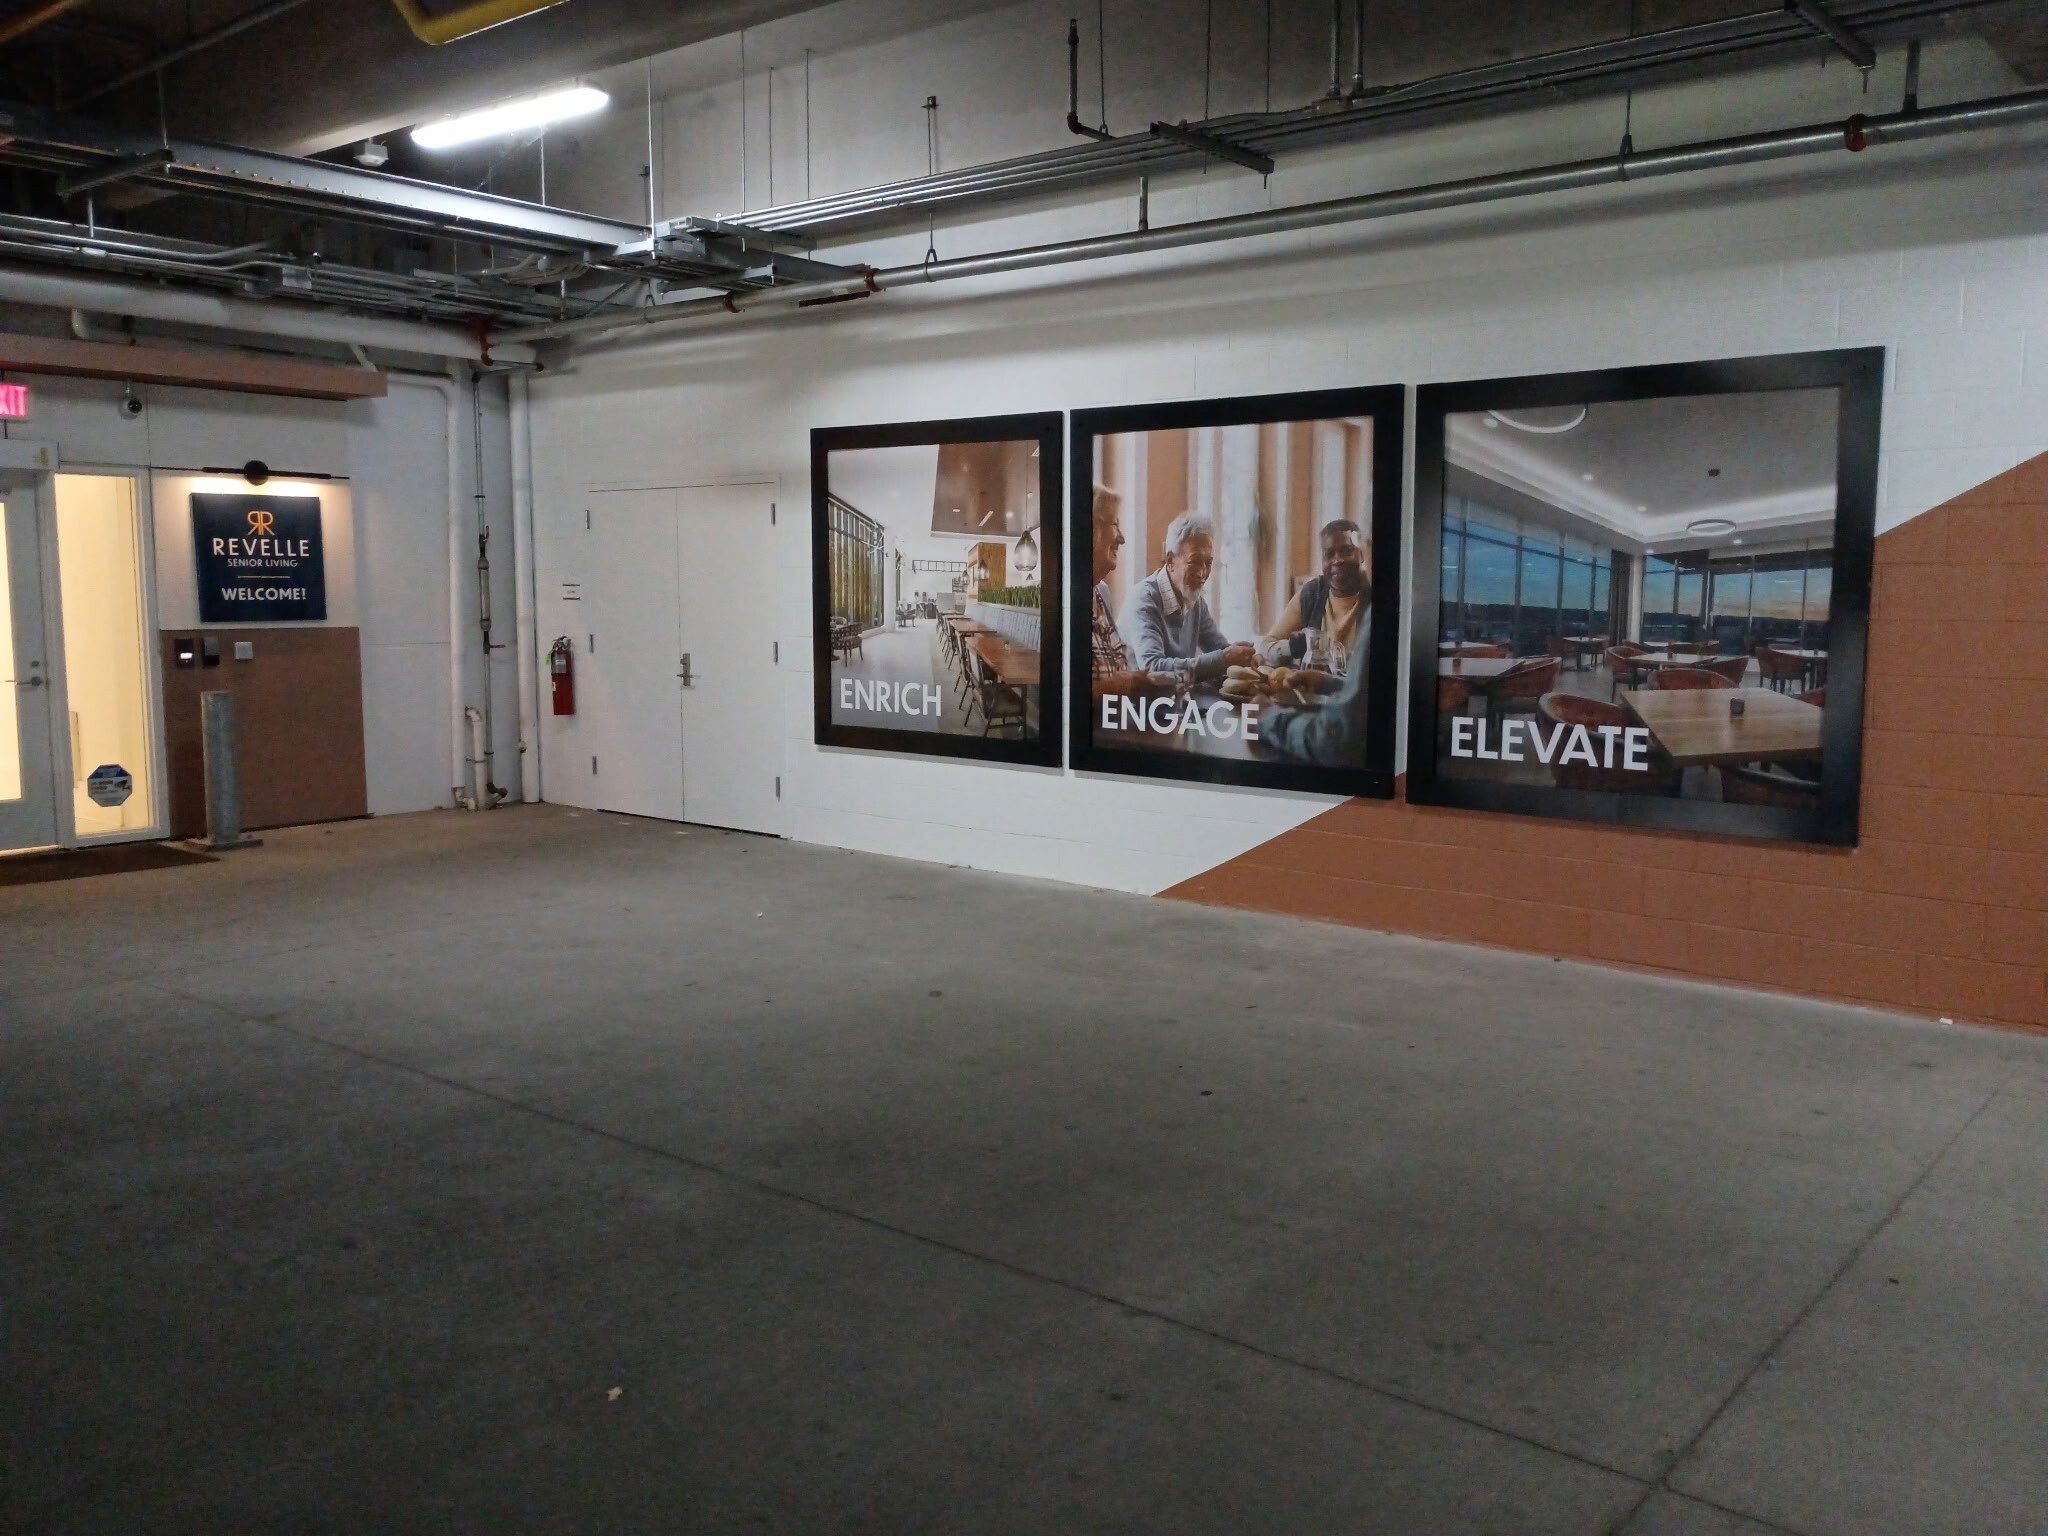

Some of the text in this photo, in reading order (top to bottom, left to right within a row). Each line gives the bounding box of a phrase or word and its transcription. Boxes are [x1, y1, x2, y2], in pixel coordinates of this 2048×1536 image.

[213, 538, 310, 556] REVELLE
[227, 558, 298, 567] SENIOR LIVING
[222, 588, 307, 600] WELCOME!
[839, 678, 943, 718] ENRICH
[1101, 694, 1260, 742] ENGAGE
[1450, 716, 1650, 772] ELEVATE
